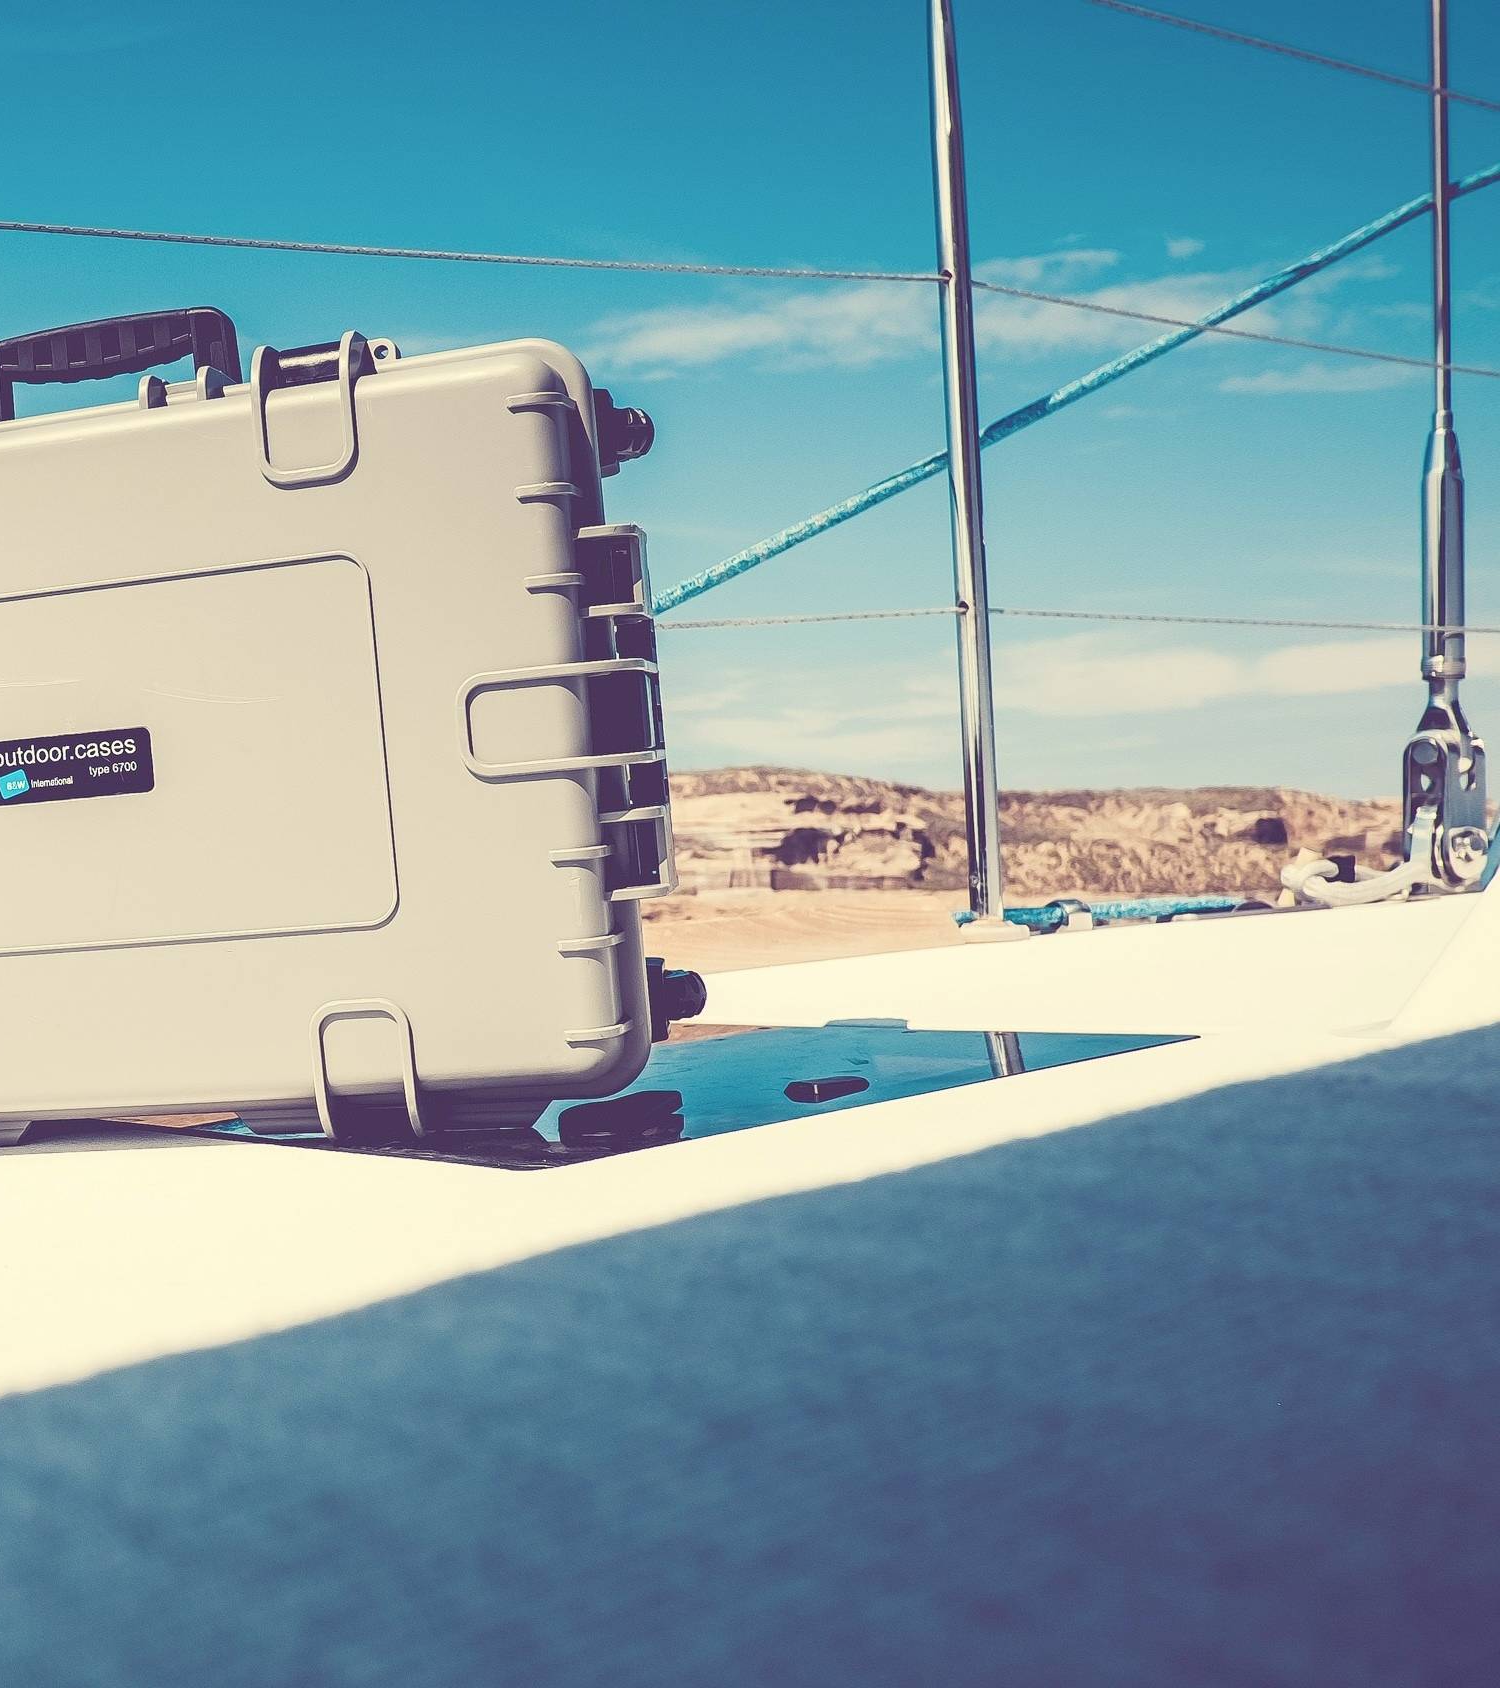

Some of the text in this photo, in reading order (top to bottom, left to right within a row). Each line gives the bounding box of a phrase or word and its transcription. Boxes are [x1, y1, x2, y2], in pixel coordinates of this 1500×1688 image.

[89, 760, 137, 778] type 6700
[31, 776, 74, 789] International
